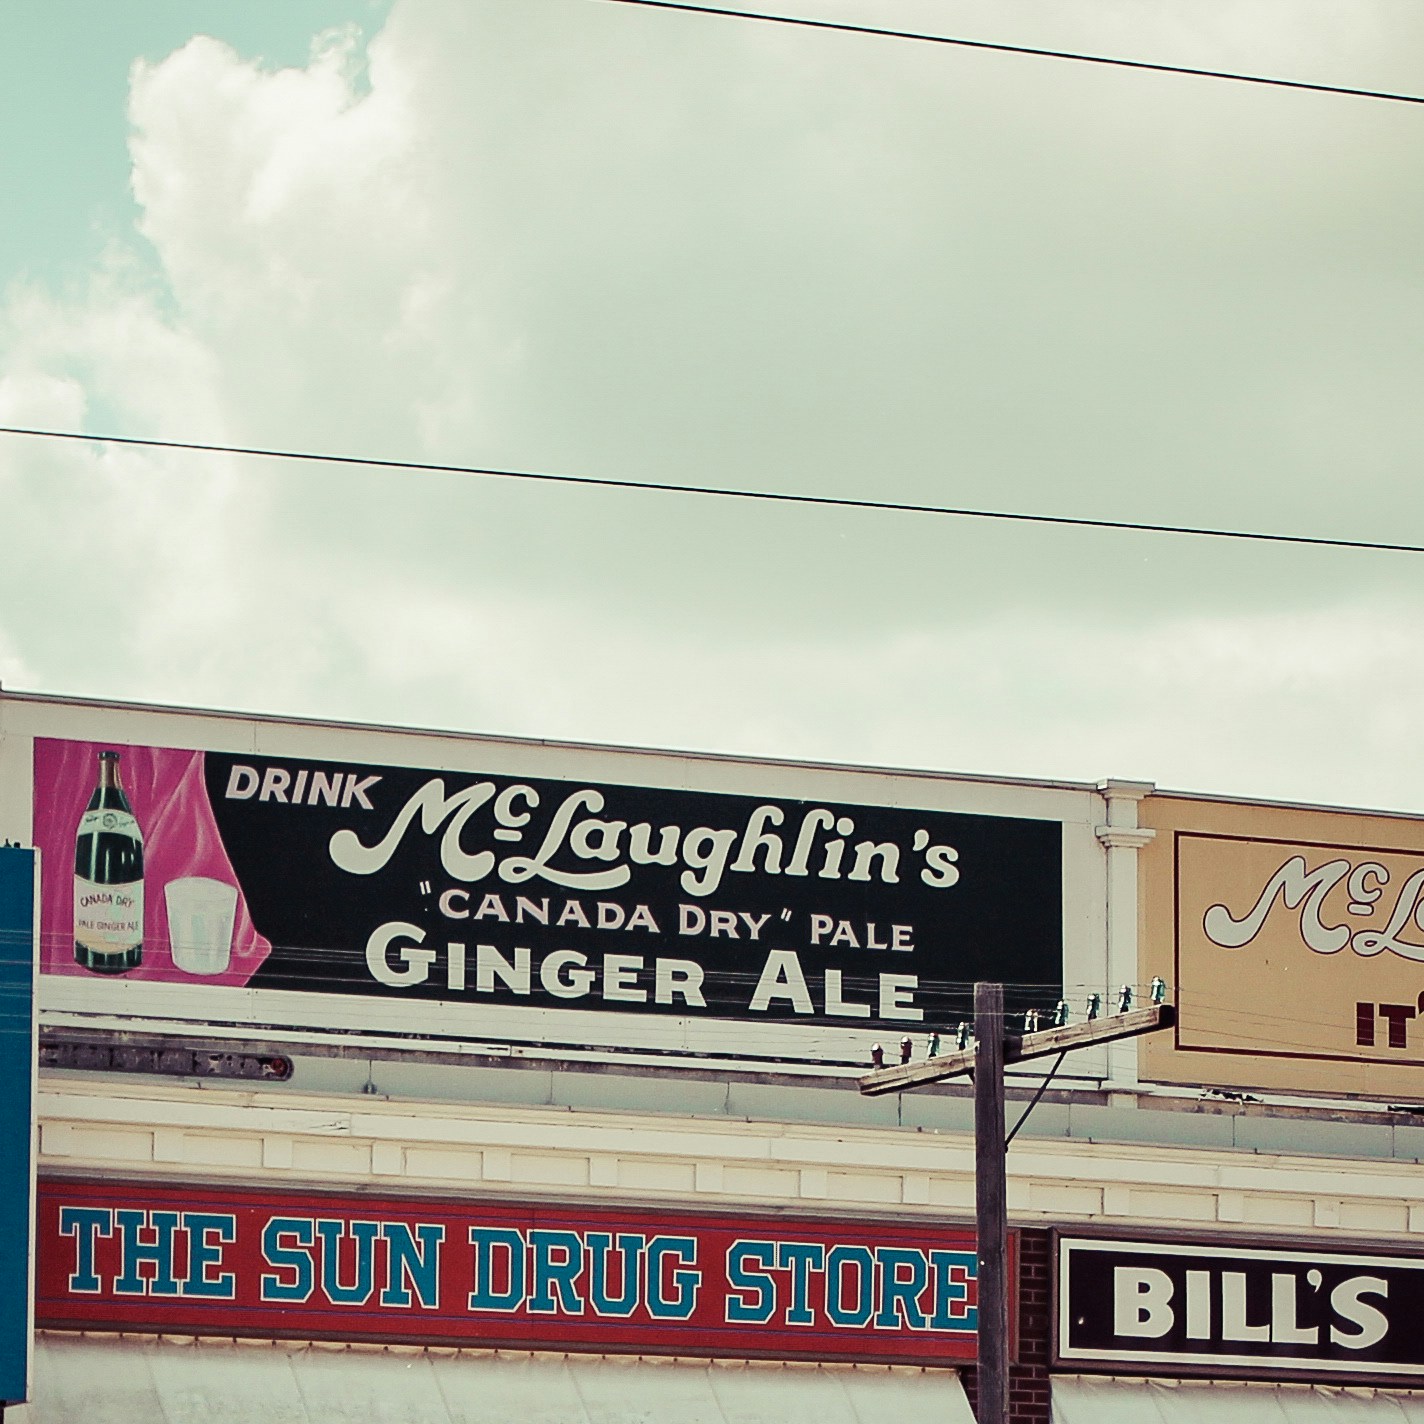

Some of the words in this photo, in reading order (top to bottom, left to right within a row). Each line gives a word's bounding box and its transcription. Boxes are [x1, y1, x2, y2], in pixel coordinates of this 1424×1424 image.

[224, 764, 383, 810] DRINK
[329, 779, 960, 897] McLaughlin's
[365, 921, 708, 1008] GINGER
[746, 949, 925, 1021] ALE
[810, 913, 915, 952] PALE
[59, 1205, 236, 1300] THE
[261, 1217, 446, 1310] SUN
[469, 1226, 702, 1320] DRUG
[725, 1239, 978, 1333] STORE
[1112, 1265, 1391, 1351] BILL'S
